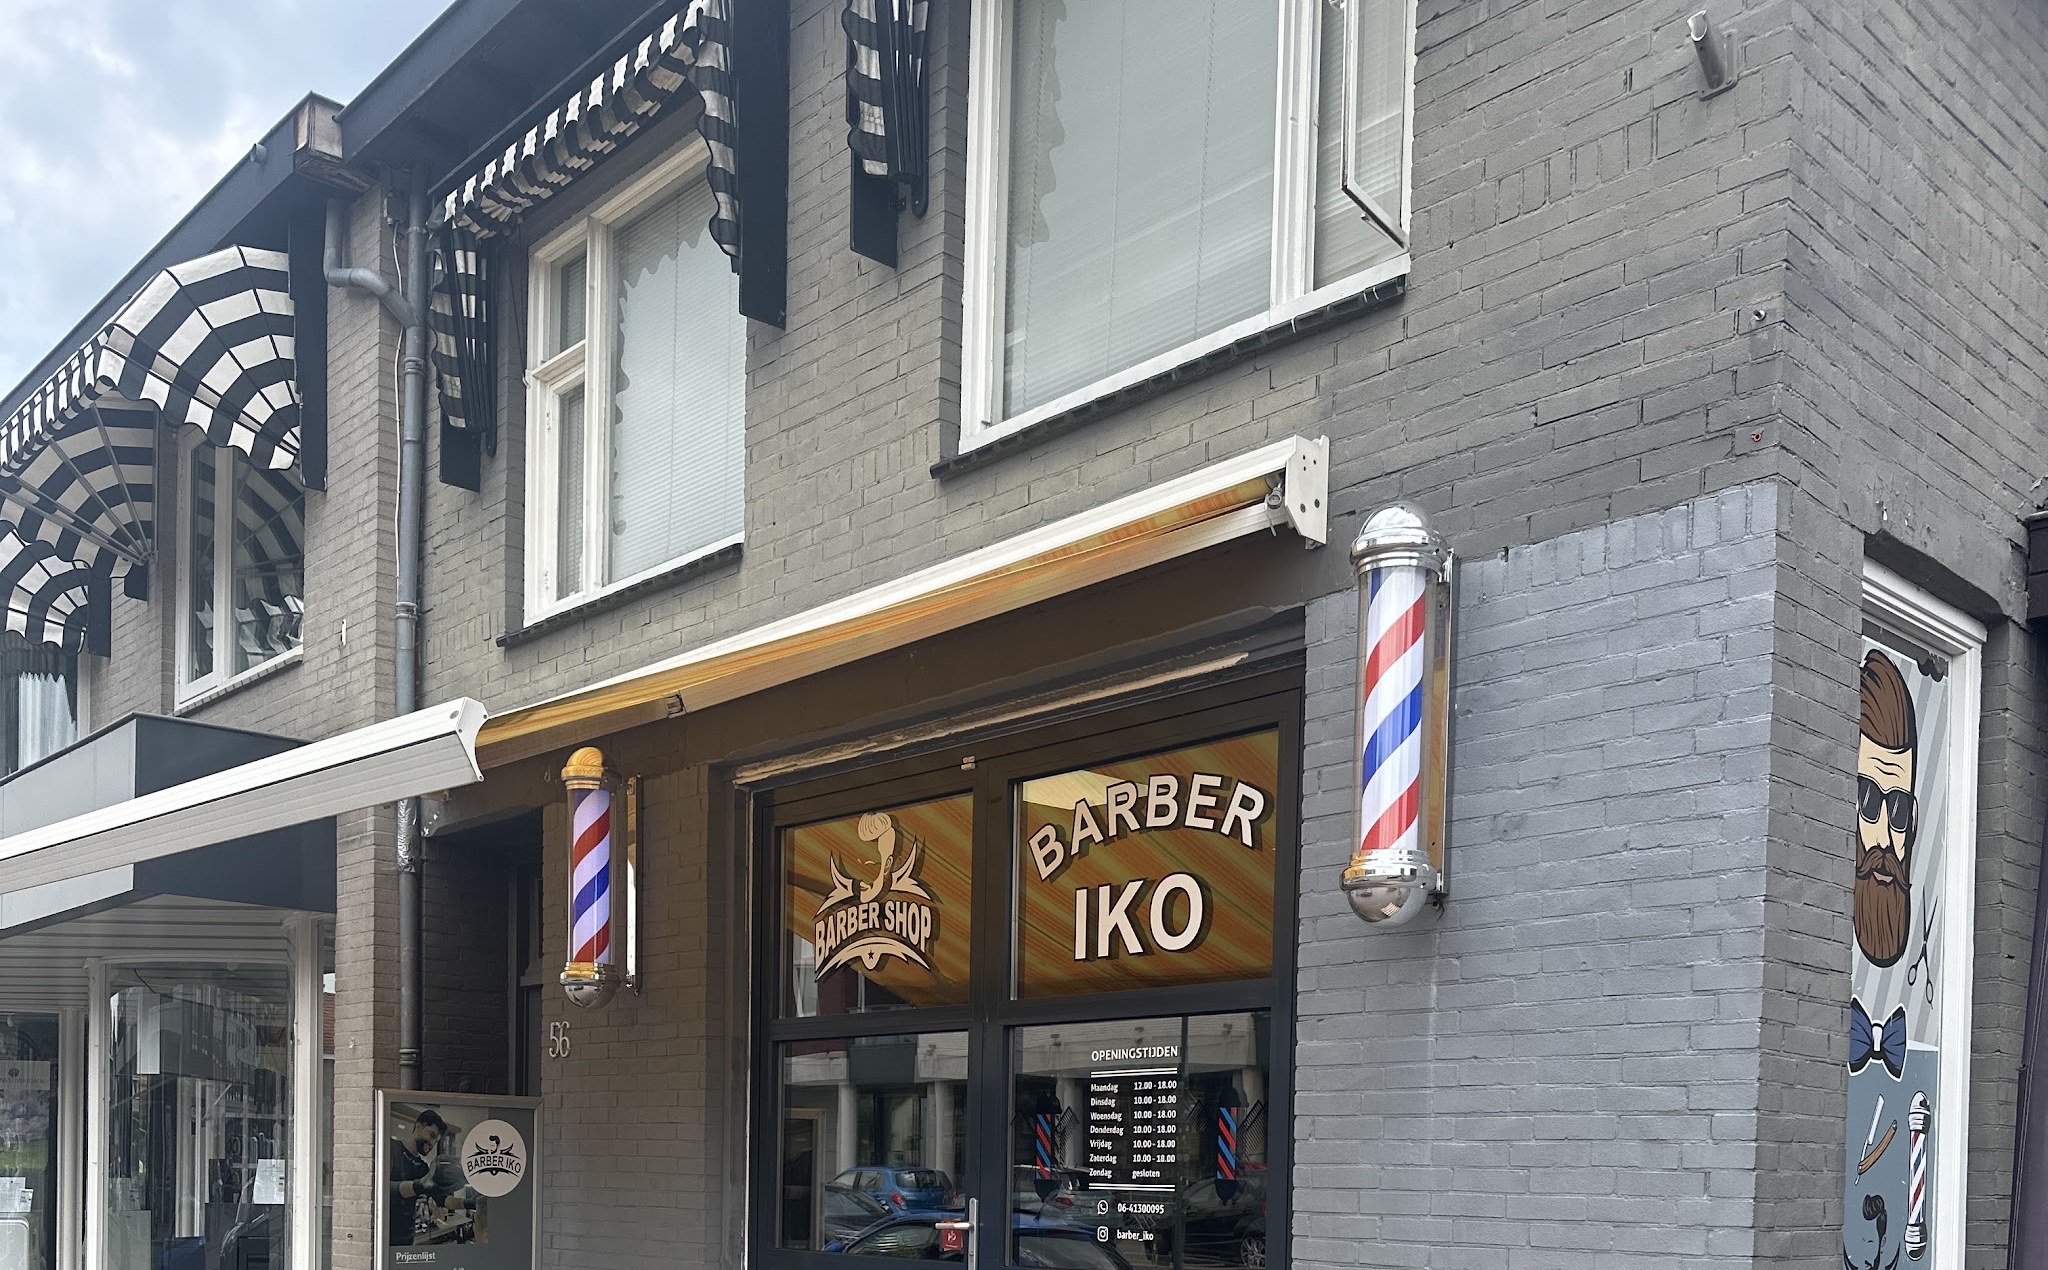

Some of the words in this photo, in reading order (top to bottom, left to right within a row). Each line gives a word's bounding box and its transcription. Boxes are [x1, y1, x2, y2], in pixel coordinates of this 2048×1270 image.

[1027, 772, 1266, 881] BARBER
[1073, 872, 1204, 962] IKO
[815, 901, 880, 972] BARBER
[883, 900, 932, 953] SHOP
[548, 1020, 571, 1058] 56
[1091, 1046, 1178, 1062] OPENINGSTIJDEN
[1090, 1083, 1119, 1093] Maandag
[1133, 1081, 1153, 1091] 12.00
[1157, 1080, 1177, 1090] 18.00
[1090, 1097, 1116, 1107] Dinsdag
[1133, 1096, 1153, 1105] 10.00
[1157, 1094, 1177, 1104] 18.00
[1090, 1111, 1123, 1122] Woensdag
[1133, 1110, 1152, 1119] 10.00
[1157, 1109, 1177, 1119] 18.00
[1089, 1125, 1124, 1136] Donderdag
[1132, 1125, 1152, 1134] 10.00
[1157, 1124, 1177, 1134] 18.00
[1089, 1139, 1113, 1150] Vrijdag
[1132, 1139, 1152, 1149] 10.00
[1156, 1139, 1176, 1149] 18.00
[466, 1156, 504, 1173] BARBER
[505, 1158, 522, 1173] IKO
[1088, 1153, 1117, 1164] Zaterdag
[1132, 1154, 1152, 1163] 10.00
[1156, 1154, 1176, 1163] 18.00
[1088, 1168, 1113, 1179] Zondag
[1131, 1168, 1161, 1180] gesloten
[1117, 1203, 1165, 1215] 06-41300095
[1116, 1229, 1154, 1242] barber_iko
[395, 1252, 436, 1264] Prijzenlijst
